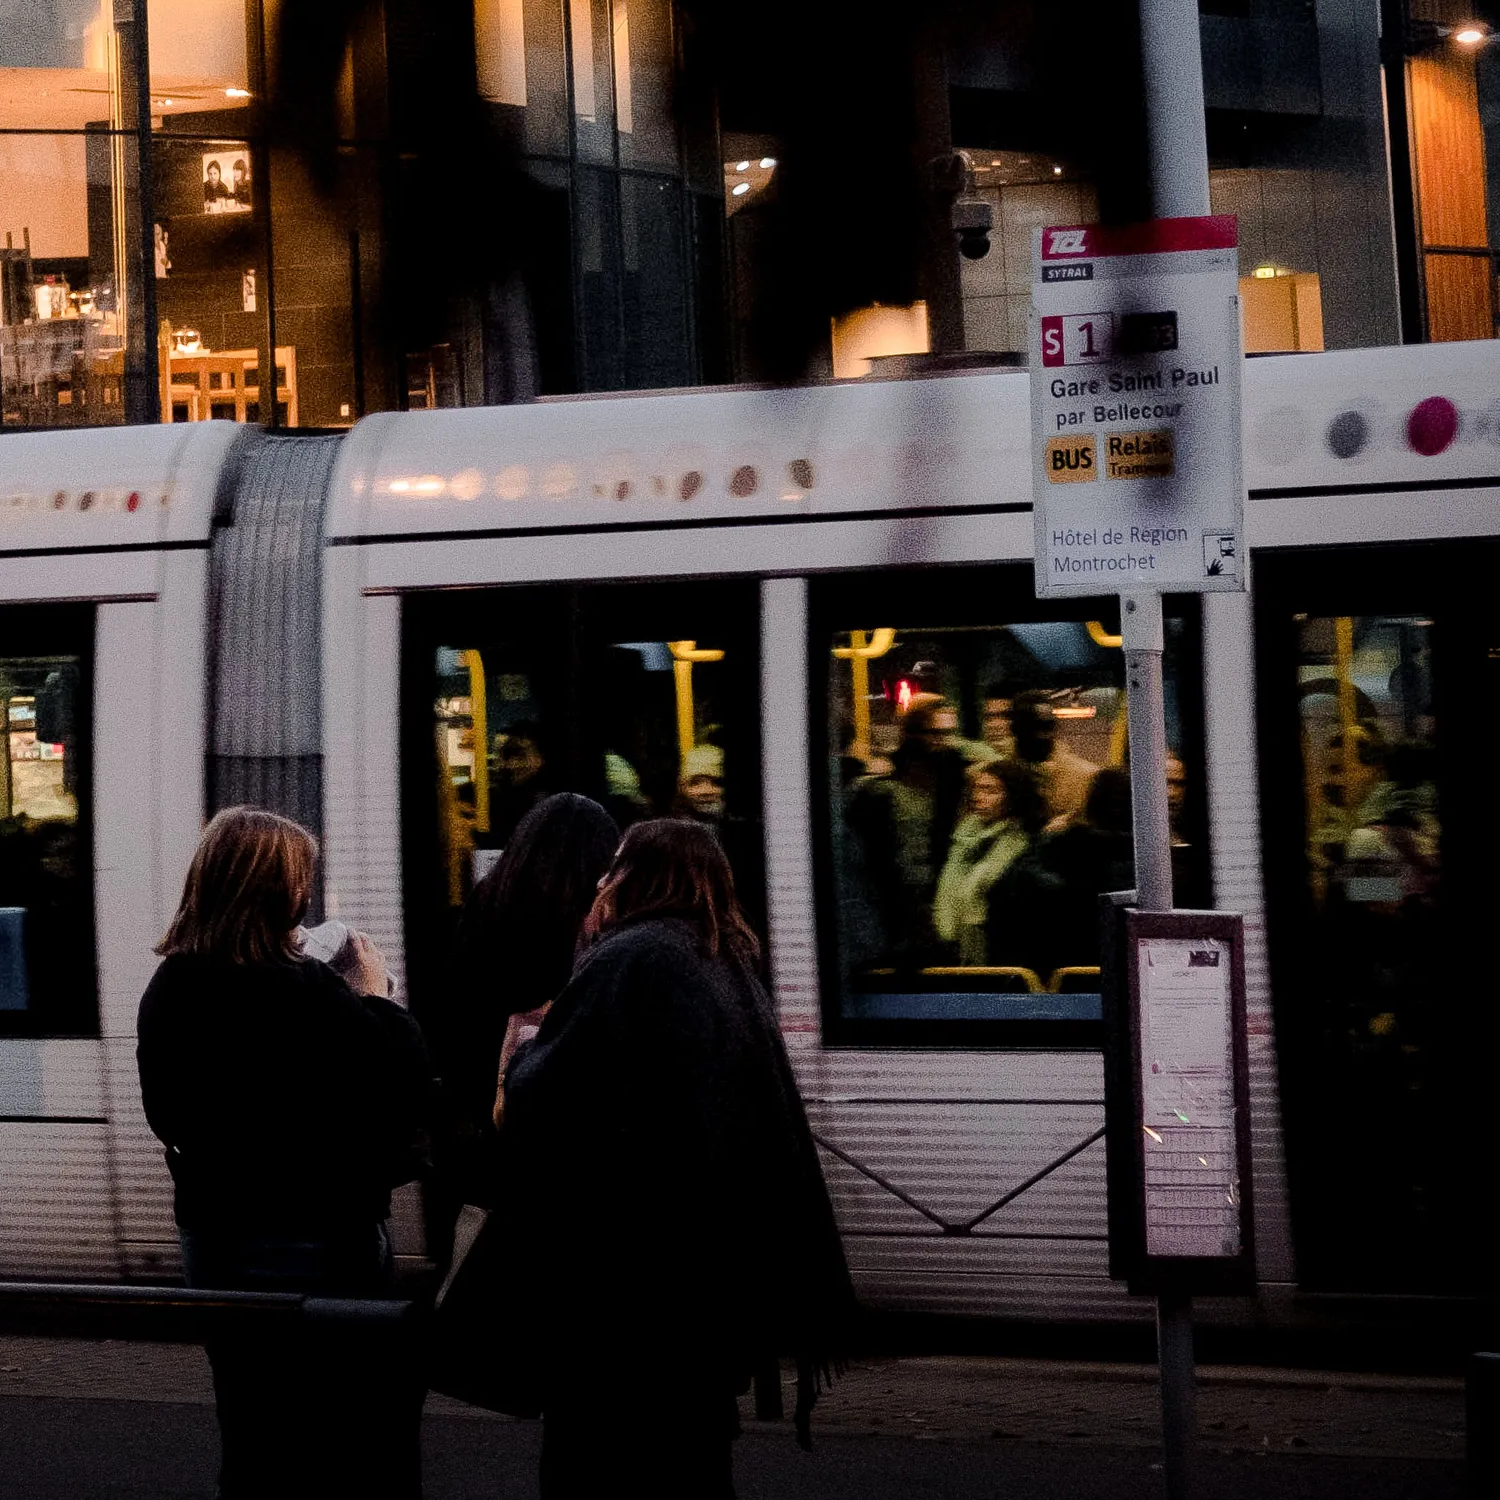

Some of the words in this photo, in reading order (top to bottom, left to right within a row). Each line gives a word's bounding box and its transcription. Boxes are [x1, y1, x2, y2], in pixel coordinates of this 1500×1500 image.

[1049, 230, 1087, 255] TCL
[1047, 267, 1088, 279] SYTRAL
[1044, 328, 1061, 356] S
[1077, 321, 1100, 358] 1
[1050, 378, 1100, 399] Gare
[1108, 370, 1164, 394] Saint
[1171, 365, 1220, 388] Paul
[1056, 411, 1086, 430] par
[1093, 402, 1184, 423] Bellecour
[1109, 433, 1171, 456] Relais
[1051, 445, 1092, 471] BUS
[1052, 528, 1098, 547] Hôtel
[1102, 528, 1123, 545] de
[1054, 554, 1156, 573] Montrochet
